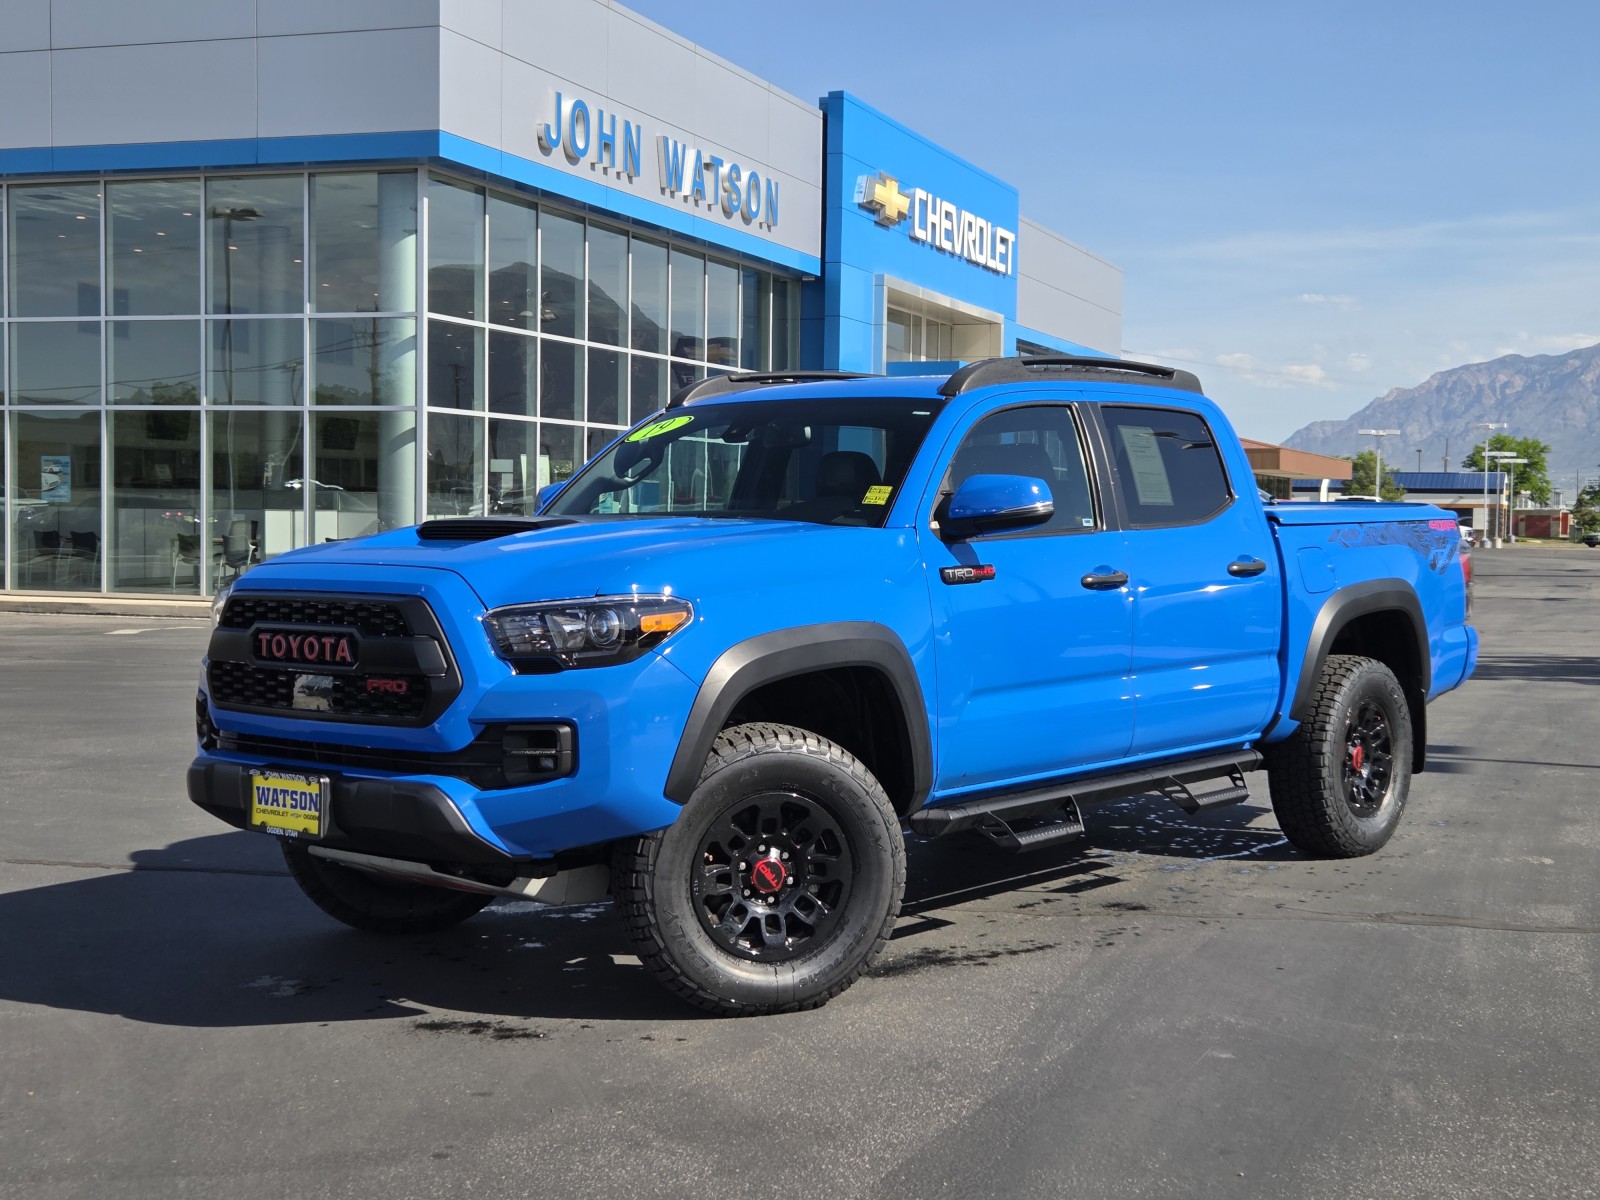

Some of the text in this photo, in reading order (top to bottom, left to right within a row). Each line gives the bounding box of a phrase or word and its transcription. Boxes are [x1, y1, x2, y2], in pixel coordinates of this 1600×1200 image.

[537, 91, 779, 226] JOHN WATSON
[913, 187, 1016, 275] CHEVROLET
[944, 568, 974, 580] TRD
[258, 633, 352, 663] TOYOTA
[366, 679, 407, 692] PRO
[256, 786, 319, 812] WATSON
[256, 808, 288, 816] CHEVROLET
[821, 774, 887, 853] KELLY
[285, 829, 298, 838] UTAH
[663, 906, 724, 986] KELLY
